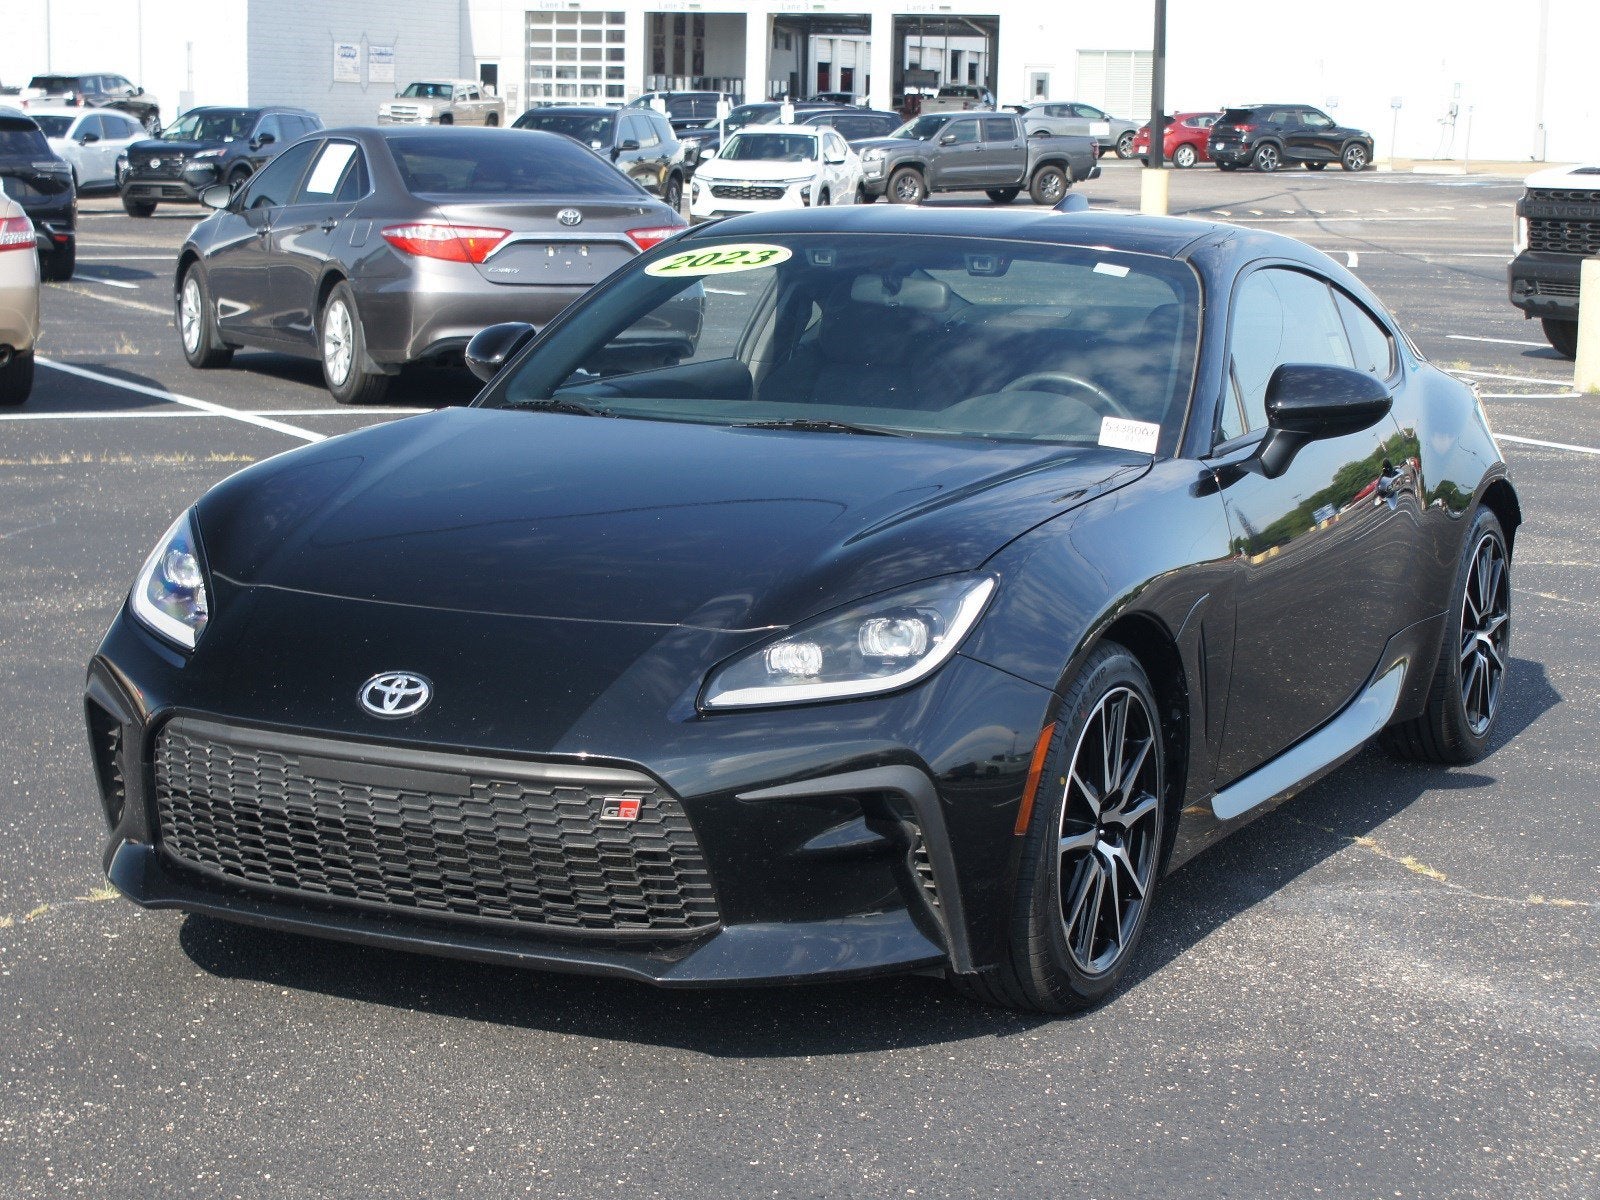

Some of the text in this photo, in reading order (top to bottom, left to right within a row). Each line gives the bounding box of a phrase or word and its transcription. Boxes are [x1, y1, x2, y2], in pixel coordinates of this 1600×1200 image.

[540, 1, 559, 9] Lane
[658, 2, 679, 10] Lane
[781, 3, 801, 11] Lane
[906, 3, 927, 12] Lane
[656, 250, 779, 272] 2023
[603, 804, 637, 818] GR
